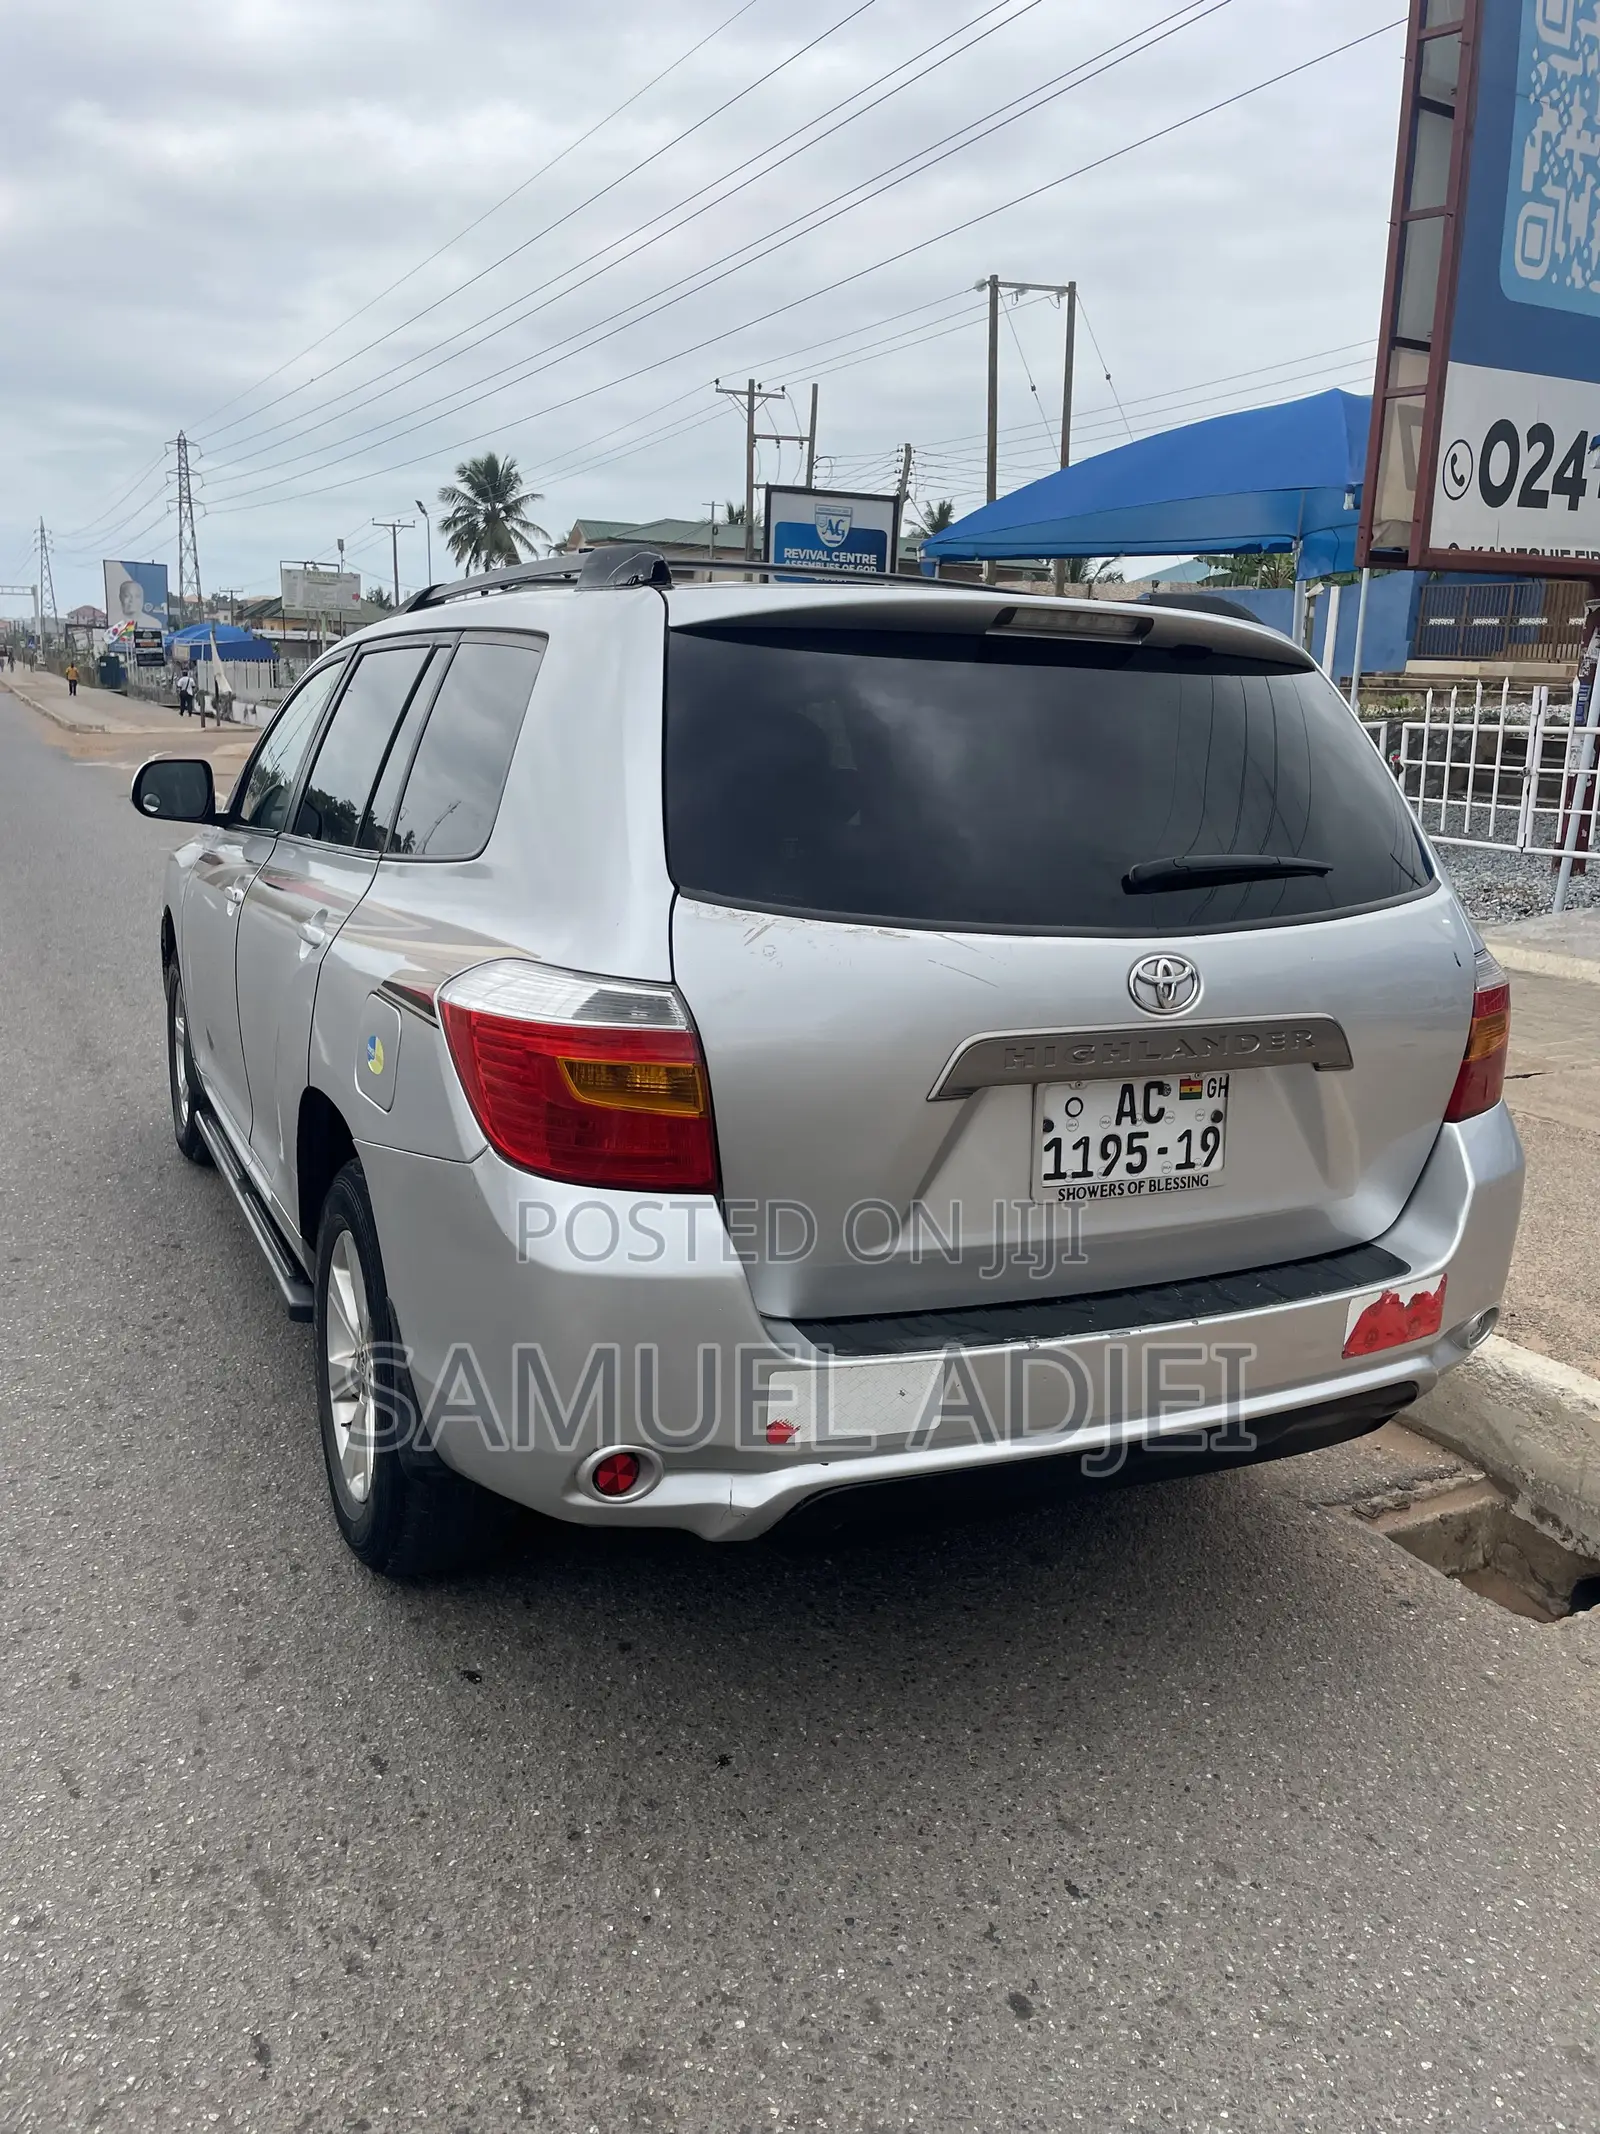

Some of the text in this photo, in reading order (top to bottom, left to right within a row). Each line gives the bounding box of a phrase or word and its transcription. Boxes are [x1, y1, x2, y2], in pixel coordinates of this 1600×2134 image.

[1478, 418, 1600, 511] 024
[784, 548, 877, 565] REVIVAL CENTRE
[1004, 1029, 1315, 1070] HIGHLANDER
[1115, 1080, 1165, 1126] AC
[1207, 1077, 1229, 1098] GH
[1043, 1126, 1221, 1180] 1195-19
[1058, 1174, 1209, 1201] SHOWERS OF BLESSING
